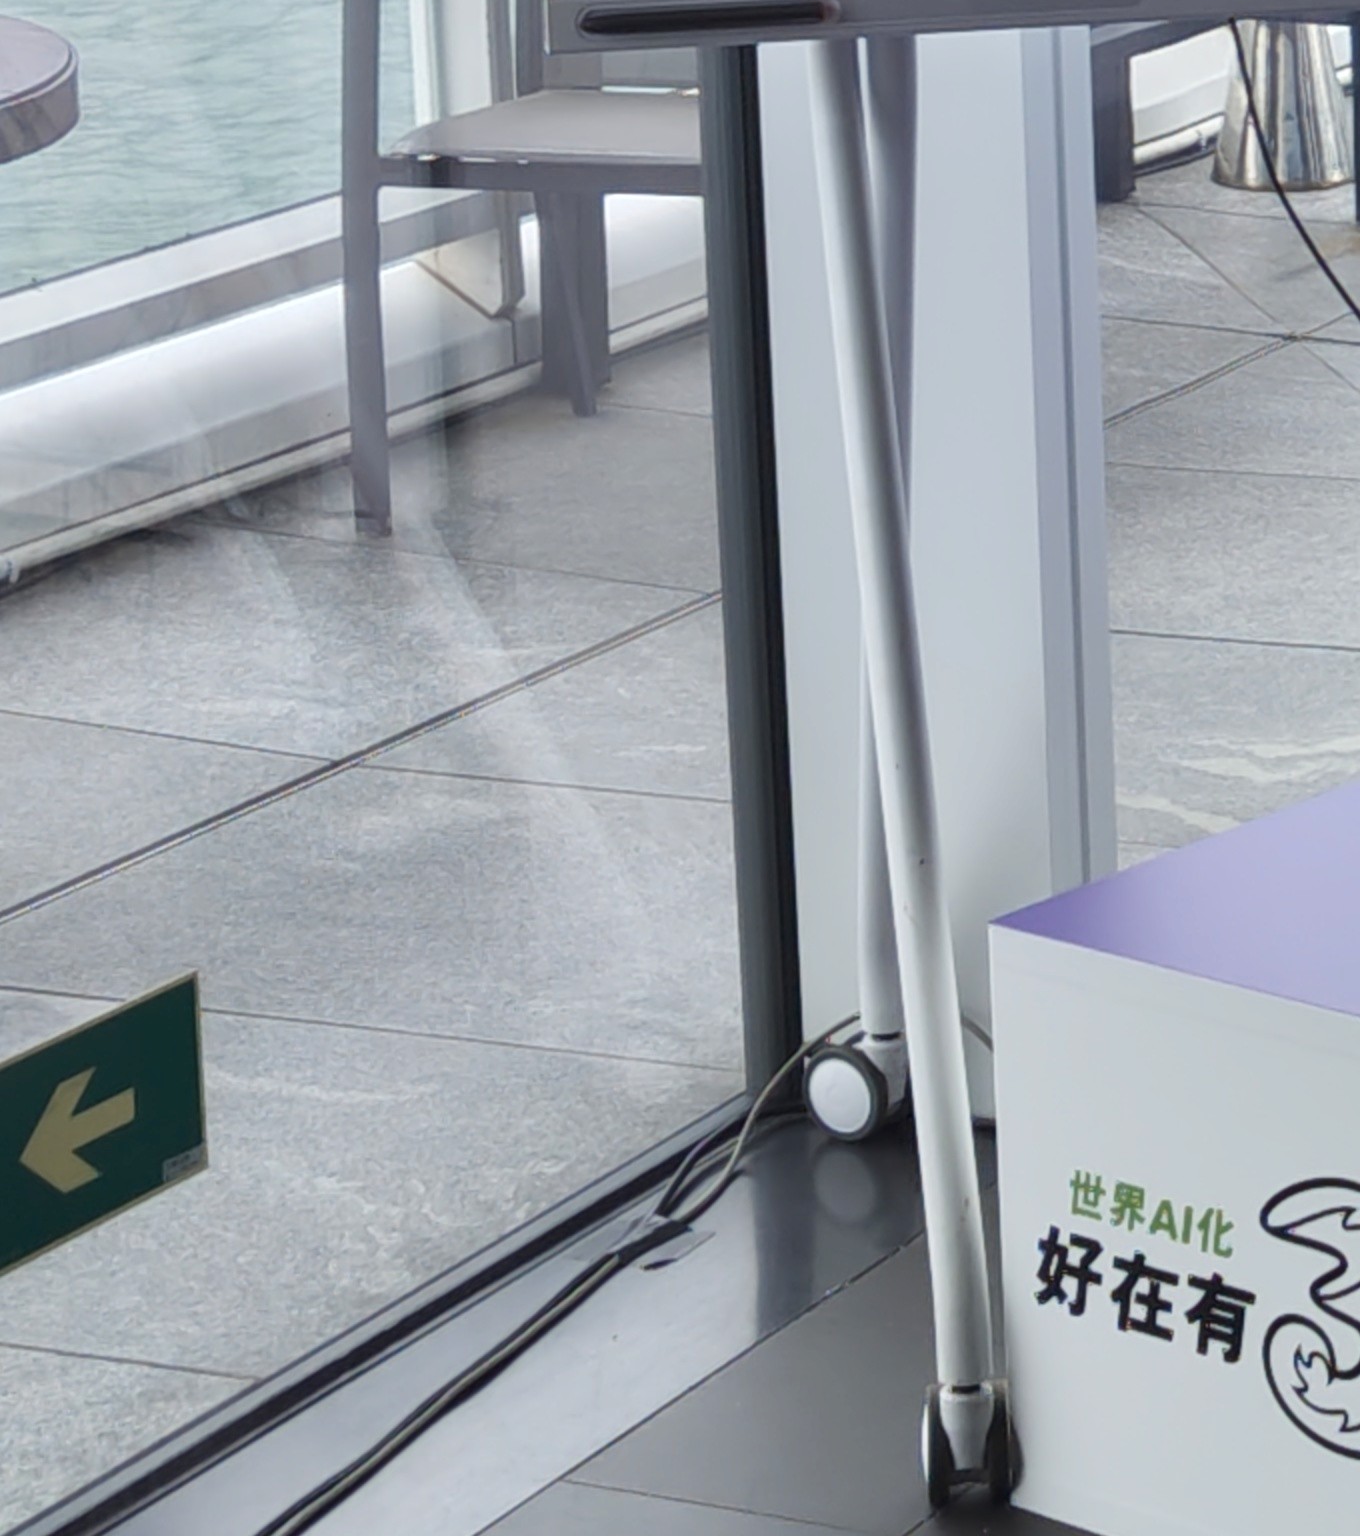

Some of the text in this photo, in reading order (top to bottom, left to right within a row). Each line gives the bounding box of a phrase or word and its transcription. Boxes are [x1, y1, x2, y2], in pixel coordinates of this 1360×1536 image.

[1068, 1169, 1235, 1259] 世界AI化
[1034, 1227, 1257, 1364] 好在有
